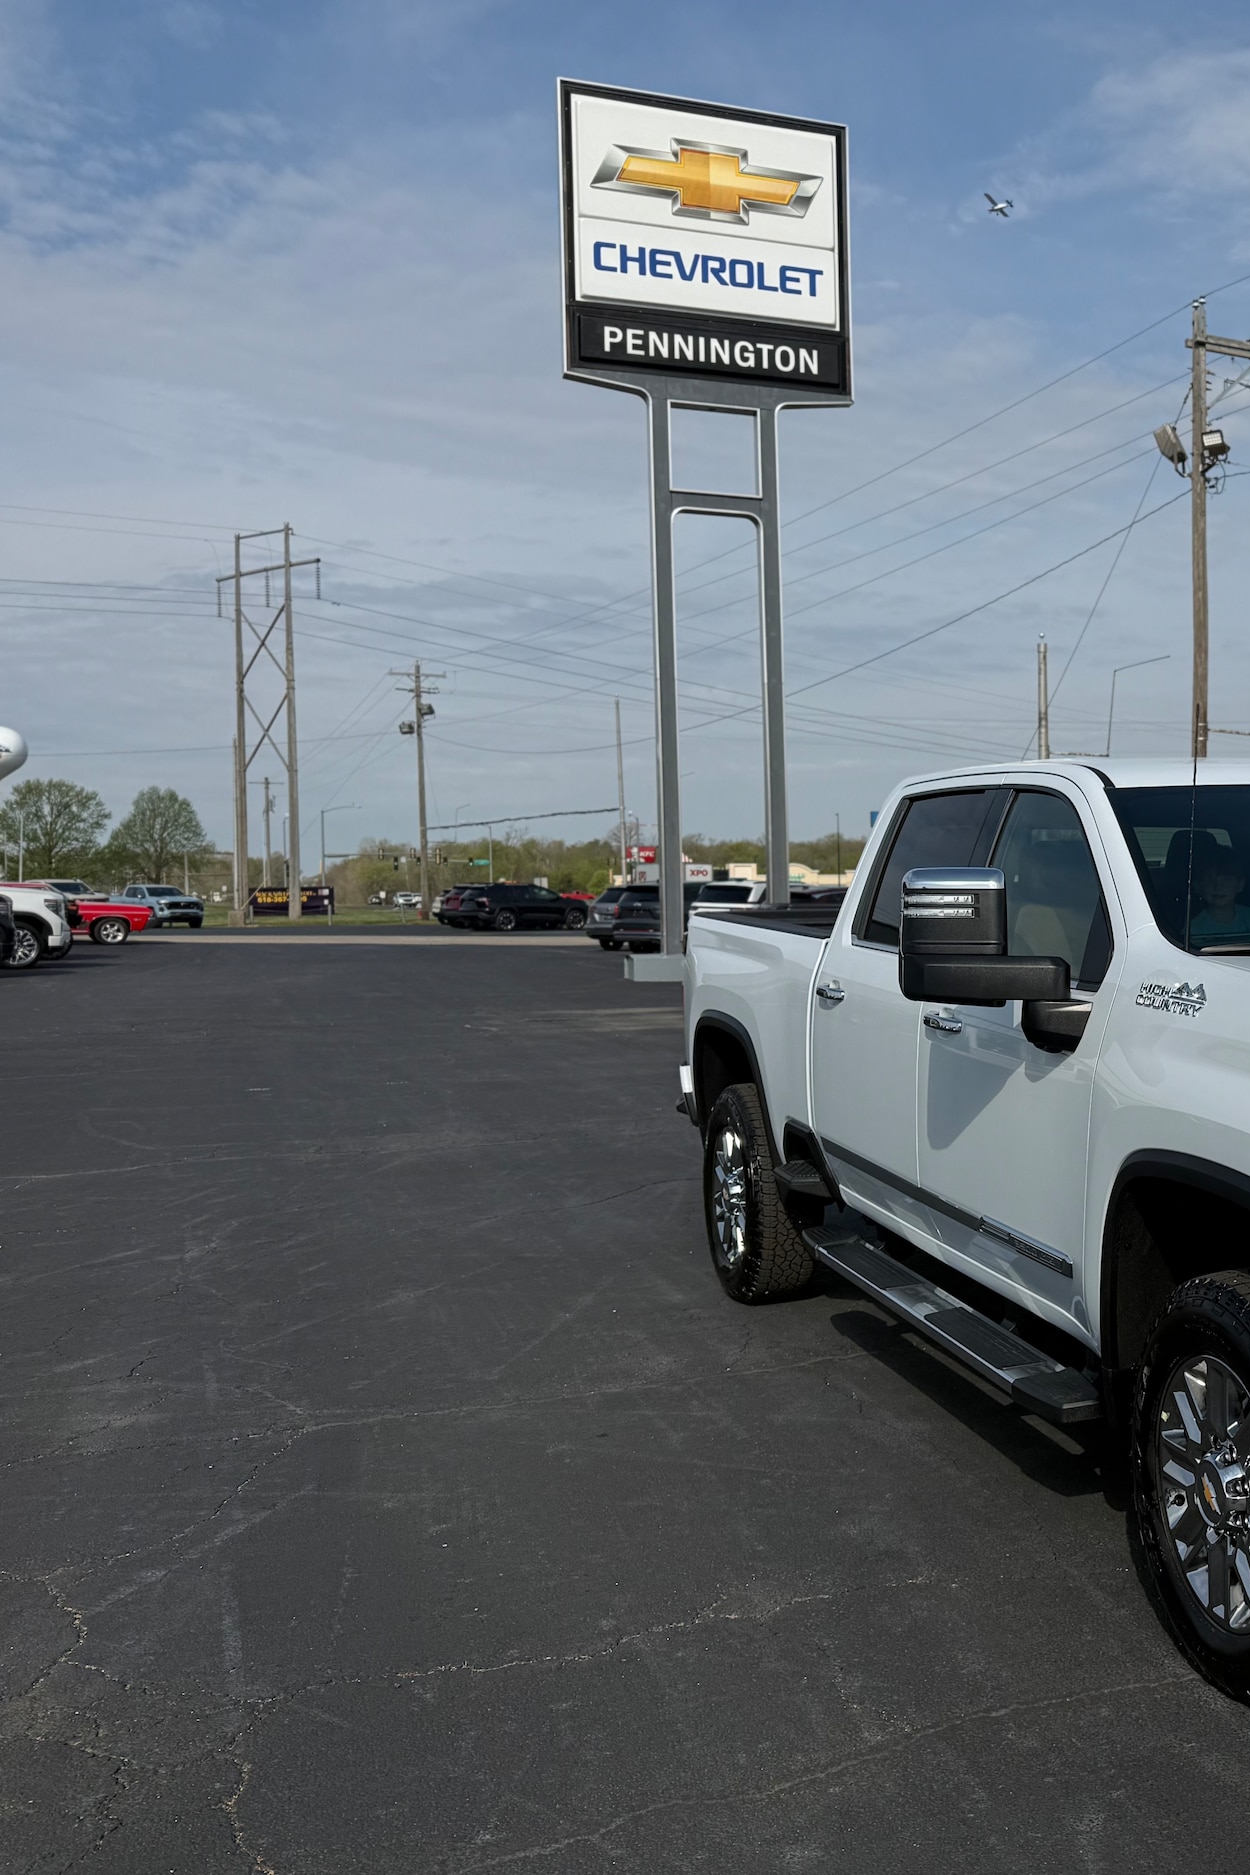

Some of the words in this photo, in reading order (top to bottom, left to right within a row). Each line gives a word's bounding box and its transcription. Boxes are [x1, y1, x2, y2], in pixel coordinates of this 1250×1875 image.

[593, 240, 824, 297] CHEVROLET
[603, 325, 819, 375] PENNINGTON
[639, 850, 656, 858] KFC
[689, 869, 709, 877] XPO
